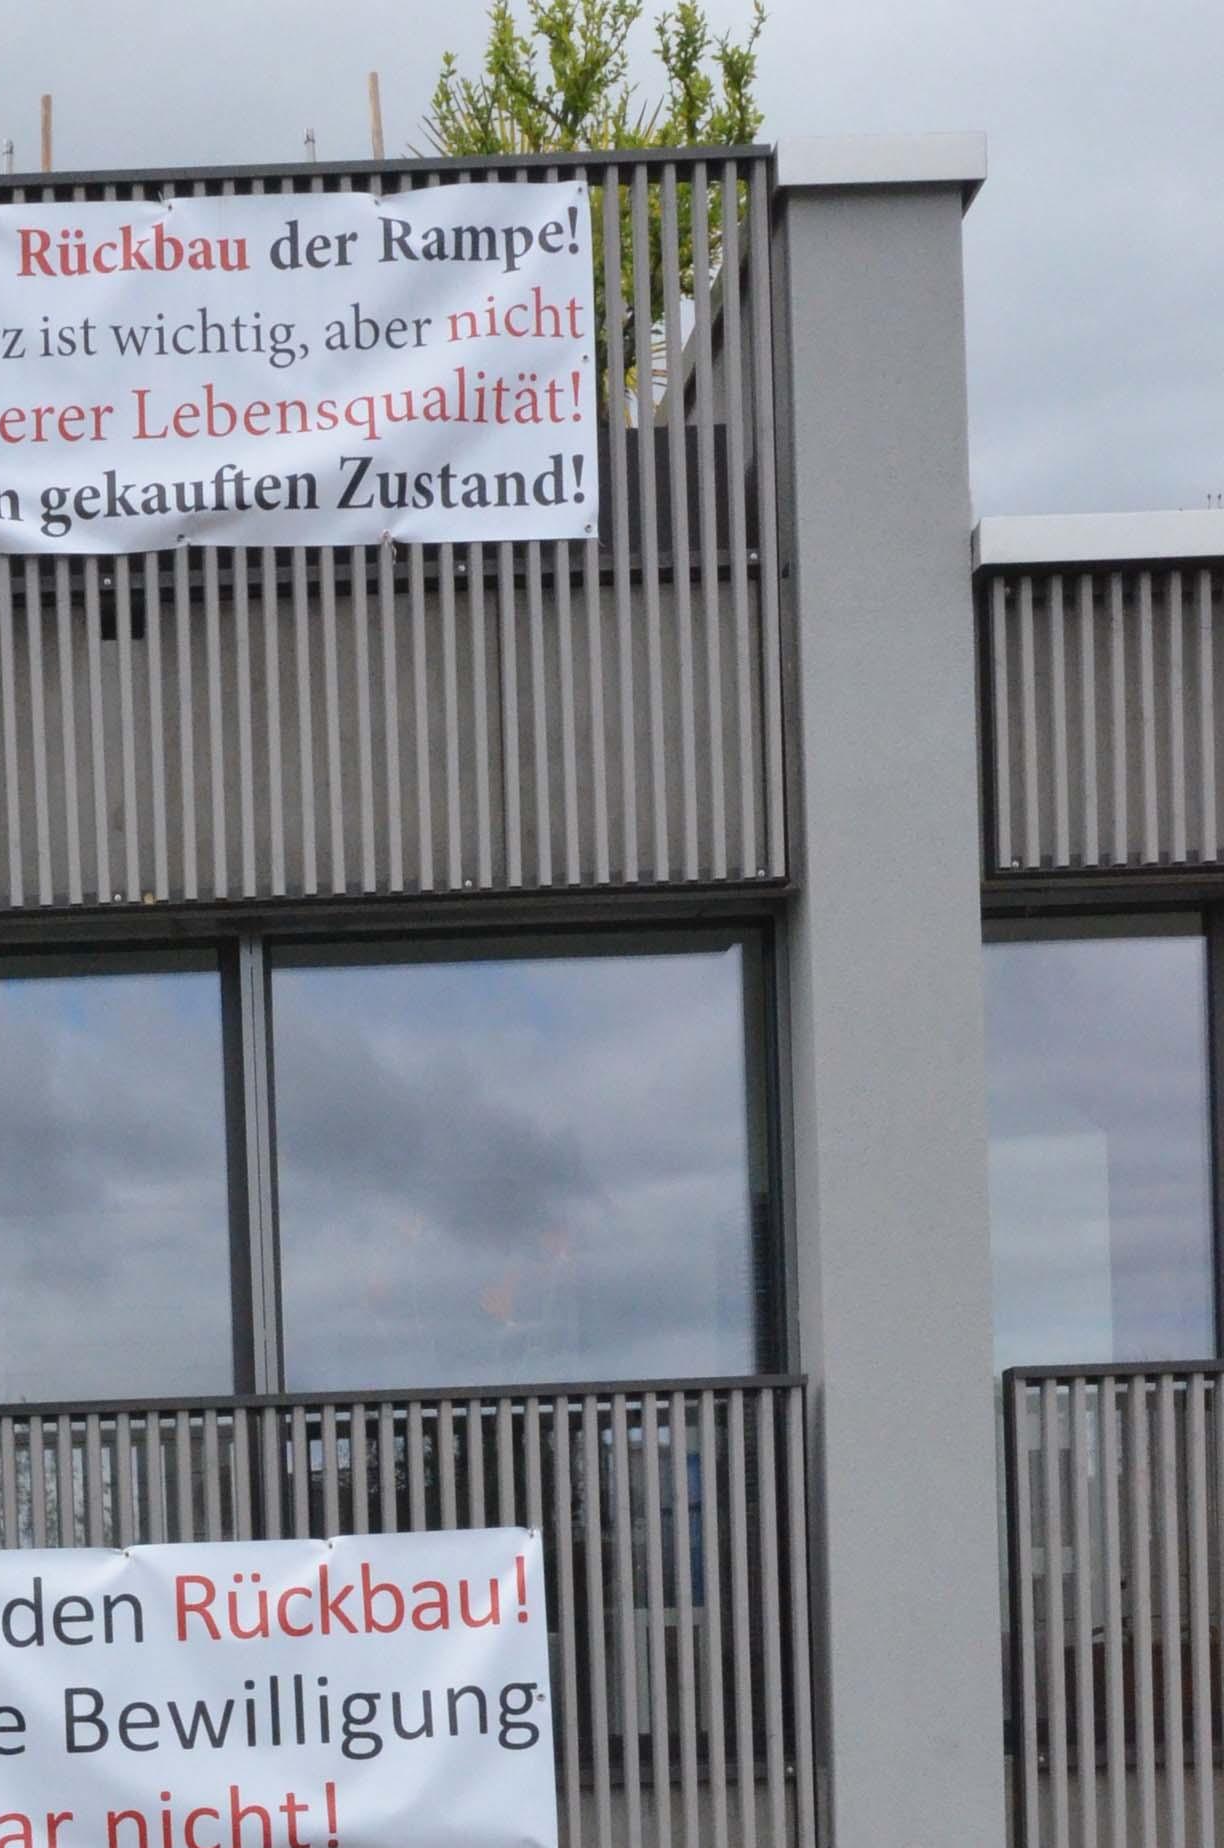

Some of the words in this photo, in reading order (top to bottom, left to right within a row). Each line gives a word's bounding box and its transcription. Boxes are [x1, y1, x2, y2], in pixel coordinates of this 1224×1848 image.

[17, 222, 250, 279] Rückbau
[270, 219, 359, 271] der
[378, 205, 581, 274] Rampe!
[40, 316, 97, 359] ist
[108, 305, 310, 369] wichtig,
[324, 301, 433, 352] aber
[447, 285, 585, 343] nicht
[132, 366, 583, 441] Lebensqualität!
[39, 463, 321, 544] gekauften
[336, 452, 586, 513] Zustand!
[2, 1576, 144, 1649] den
[176, 1555, 530, 1642] Rückbau!
[64, 1673, 541, 1761] Bewilligung
